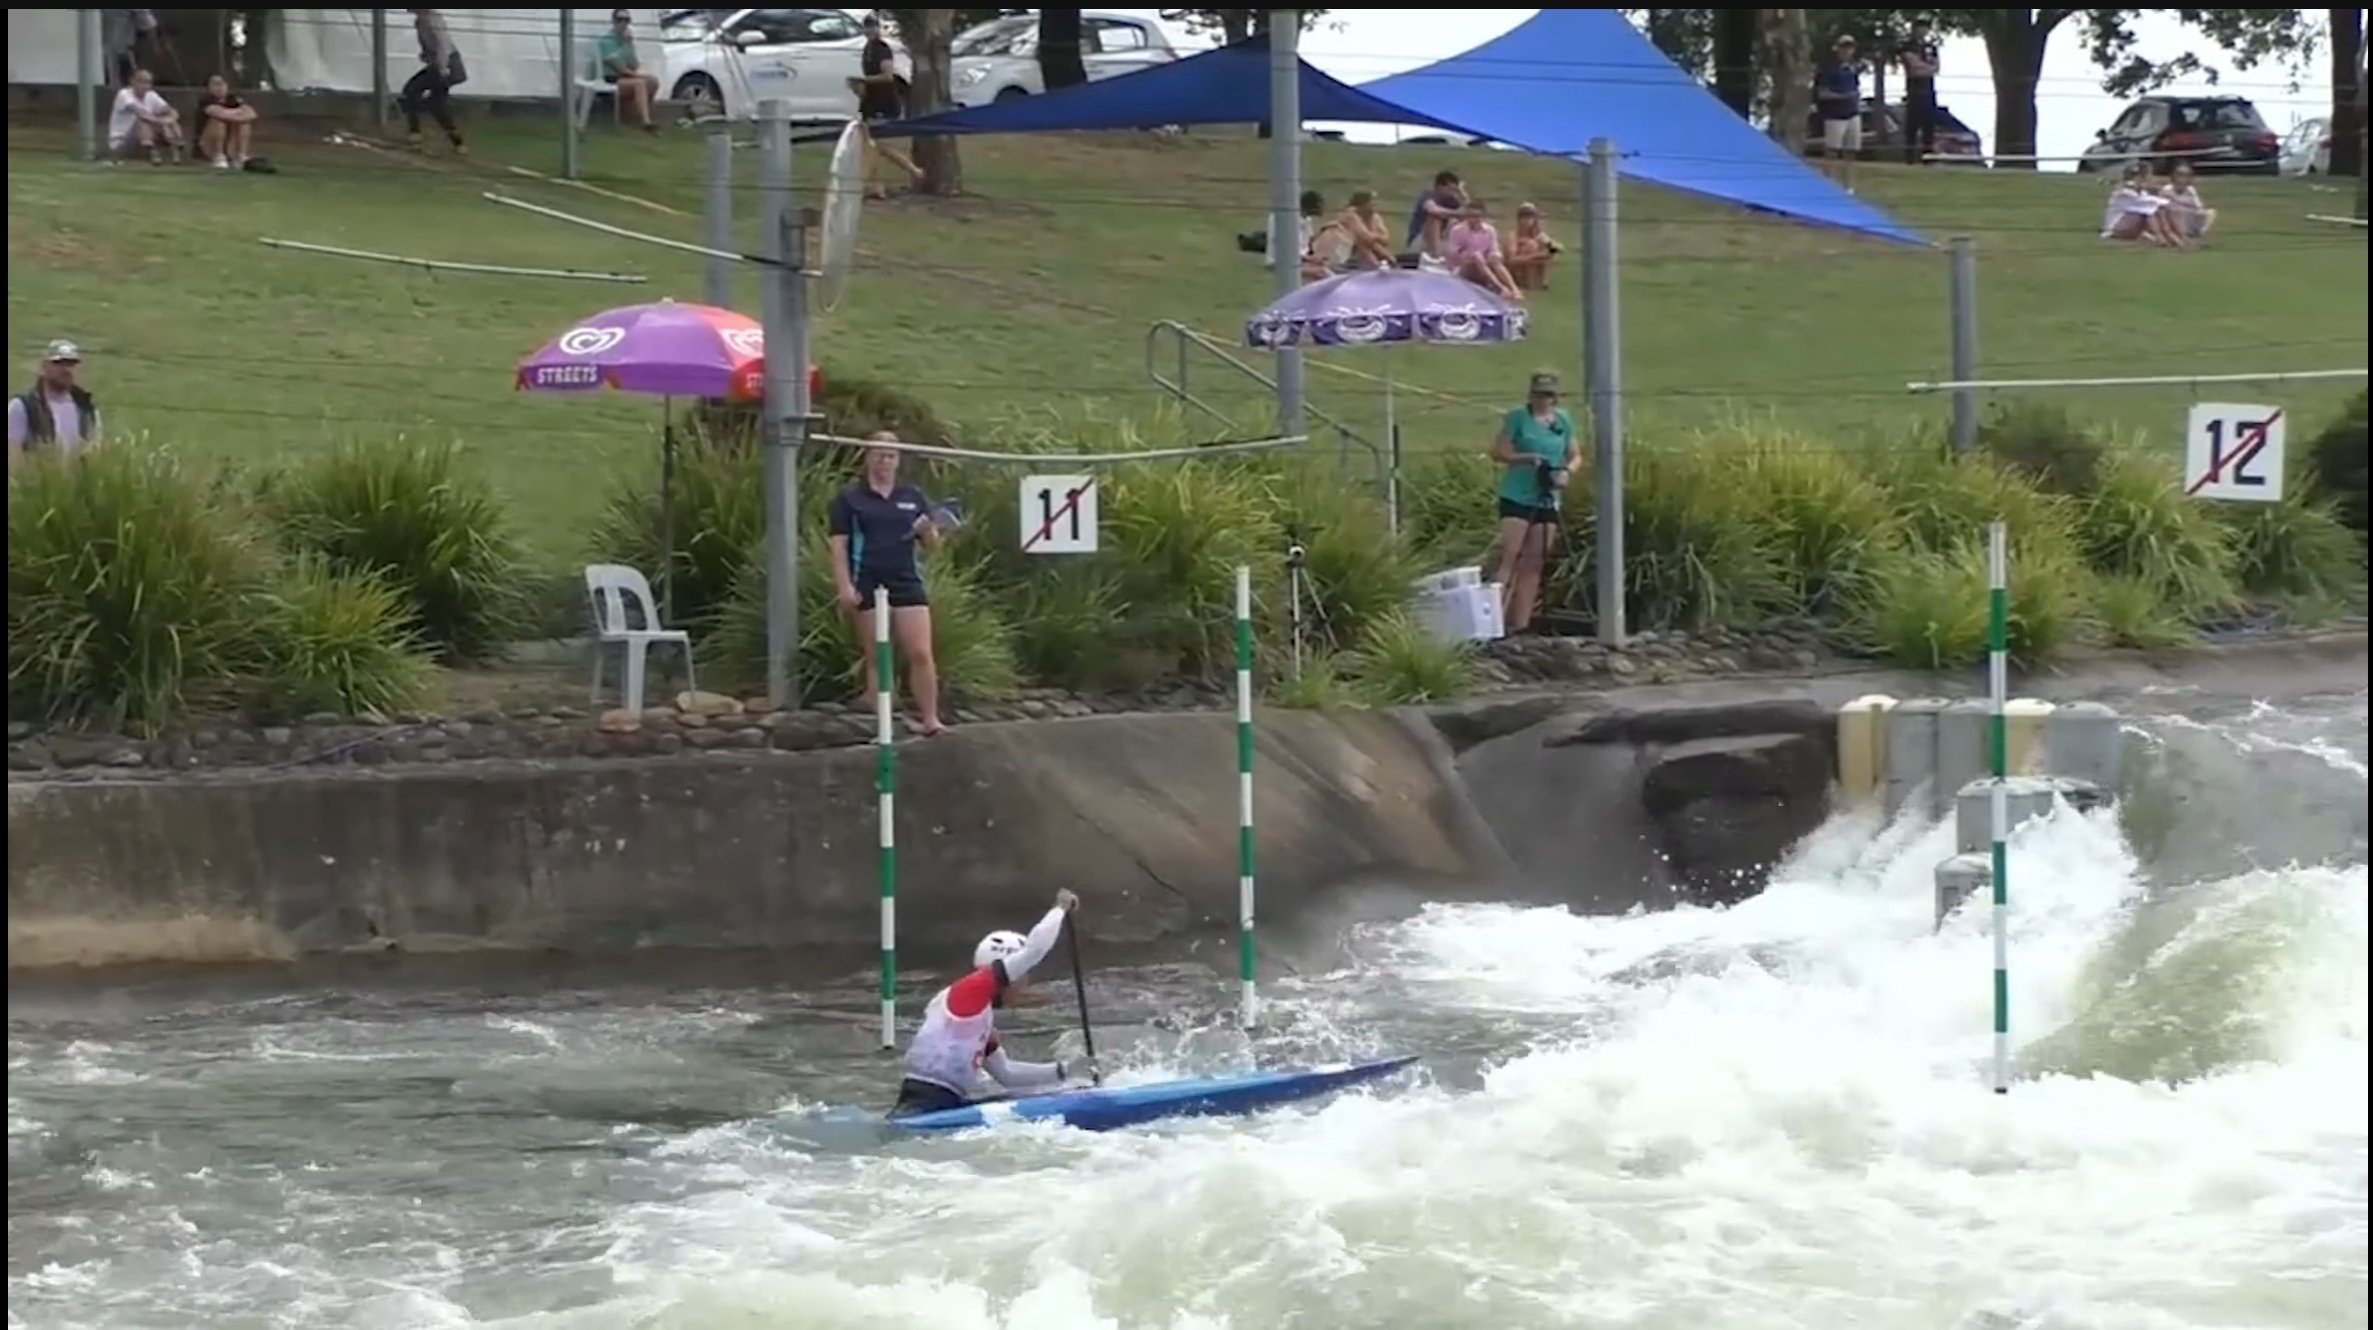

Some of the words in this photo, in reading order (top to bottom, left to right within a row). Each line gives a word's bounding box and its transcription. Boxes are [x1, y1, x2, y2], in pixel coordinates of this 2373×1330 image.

[537, 366, 598, 384] STREETS
[2205, 419, 2267, 485] 12
[1038, 488, 1079, 541] 11
